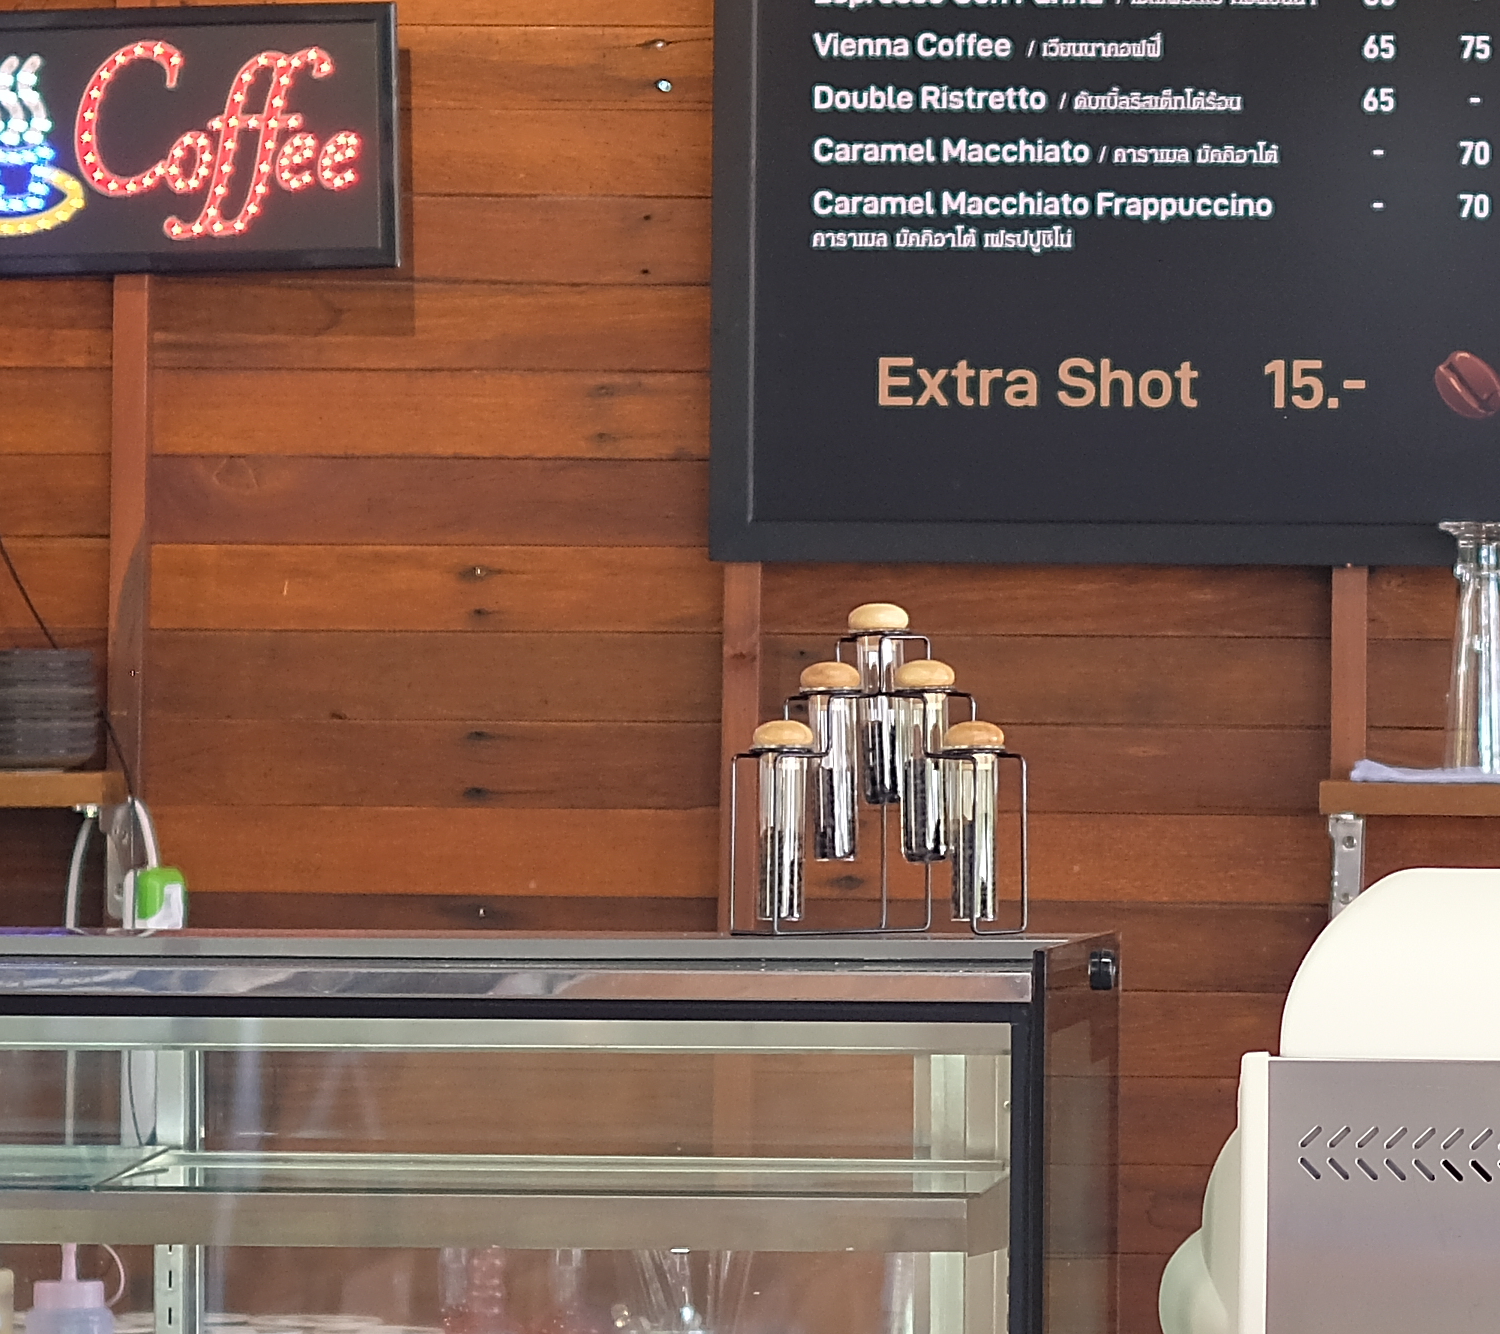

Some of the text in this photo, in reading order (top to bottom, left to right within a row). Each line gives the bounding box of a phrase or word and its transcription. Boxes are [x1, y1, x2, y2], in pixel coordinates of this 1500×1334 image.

[812, 32, 1491, 60] Vienna Coffee 65 75
[813, 85, 1395, 112] Double Ristretto 65
[74, 39, 361, 240] Coffee
[813, 137, 936, 163] Caramel
[942, 138, 1090, 163] Macchiato
[1459, 140, 1490, 166] 70
[813, 190, 935, 215] Caramel
[941, 190, 1090, 216] Macchiato
[1096, 191, 1273, 221] Frappuccino
[1459, 193, 1490, 219] 70
[878, 356, 1366, 410] Extra Shot 15.-
